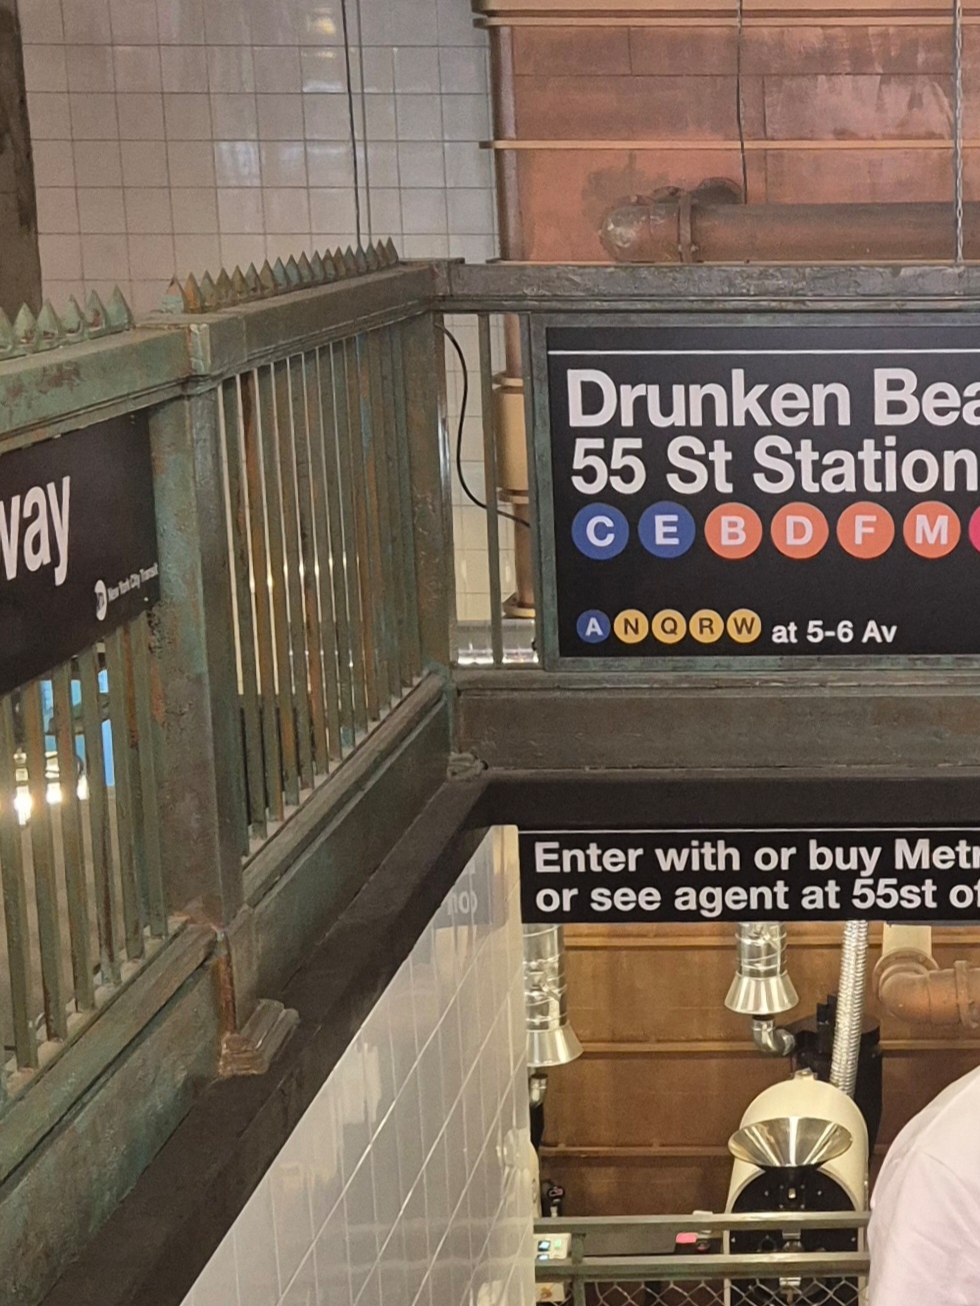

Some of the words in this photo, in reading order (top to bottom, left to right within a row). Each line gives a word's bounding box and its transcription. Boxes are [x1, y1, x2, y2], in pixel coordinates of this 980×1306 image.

[566, 368, 851, 428] Drunken
[570, 437, 647, 495] 55
[665, 435, 734, 495] St
[752, 434, 979, 494] Station
[585, 515, 615, 546] C
[654, 515, 680, 545] E
[719, 515, 747, 546] B
[785, 515, 814, 545] D
[853, 515, 877, 544] F
[914, 514, 949, 545] M
[732, 616, 757, 635] W
[771, 621, 798, 644] at
[806, 620, 854, 643] 5-6
[861, 619, 898, 643] Av
[534, 841, 644, 873] Enter
[654, 839, 741, 872] with
[753, 846, 797, 871] or
[809, 839, 882, 877] buy
[535, 887, 579, 912] or
[590, 886, 662, 912] see
[673, 881, 790, 918] agent
[800, 879, 841, 910] at
[851, 878, 938, 909] 55st
